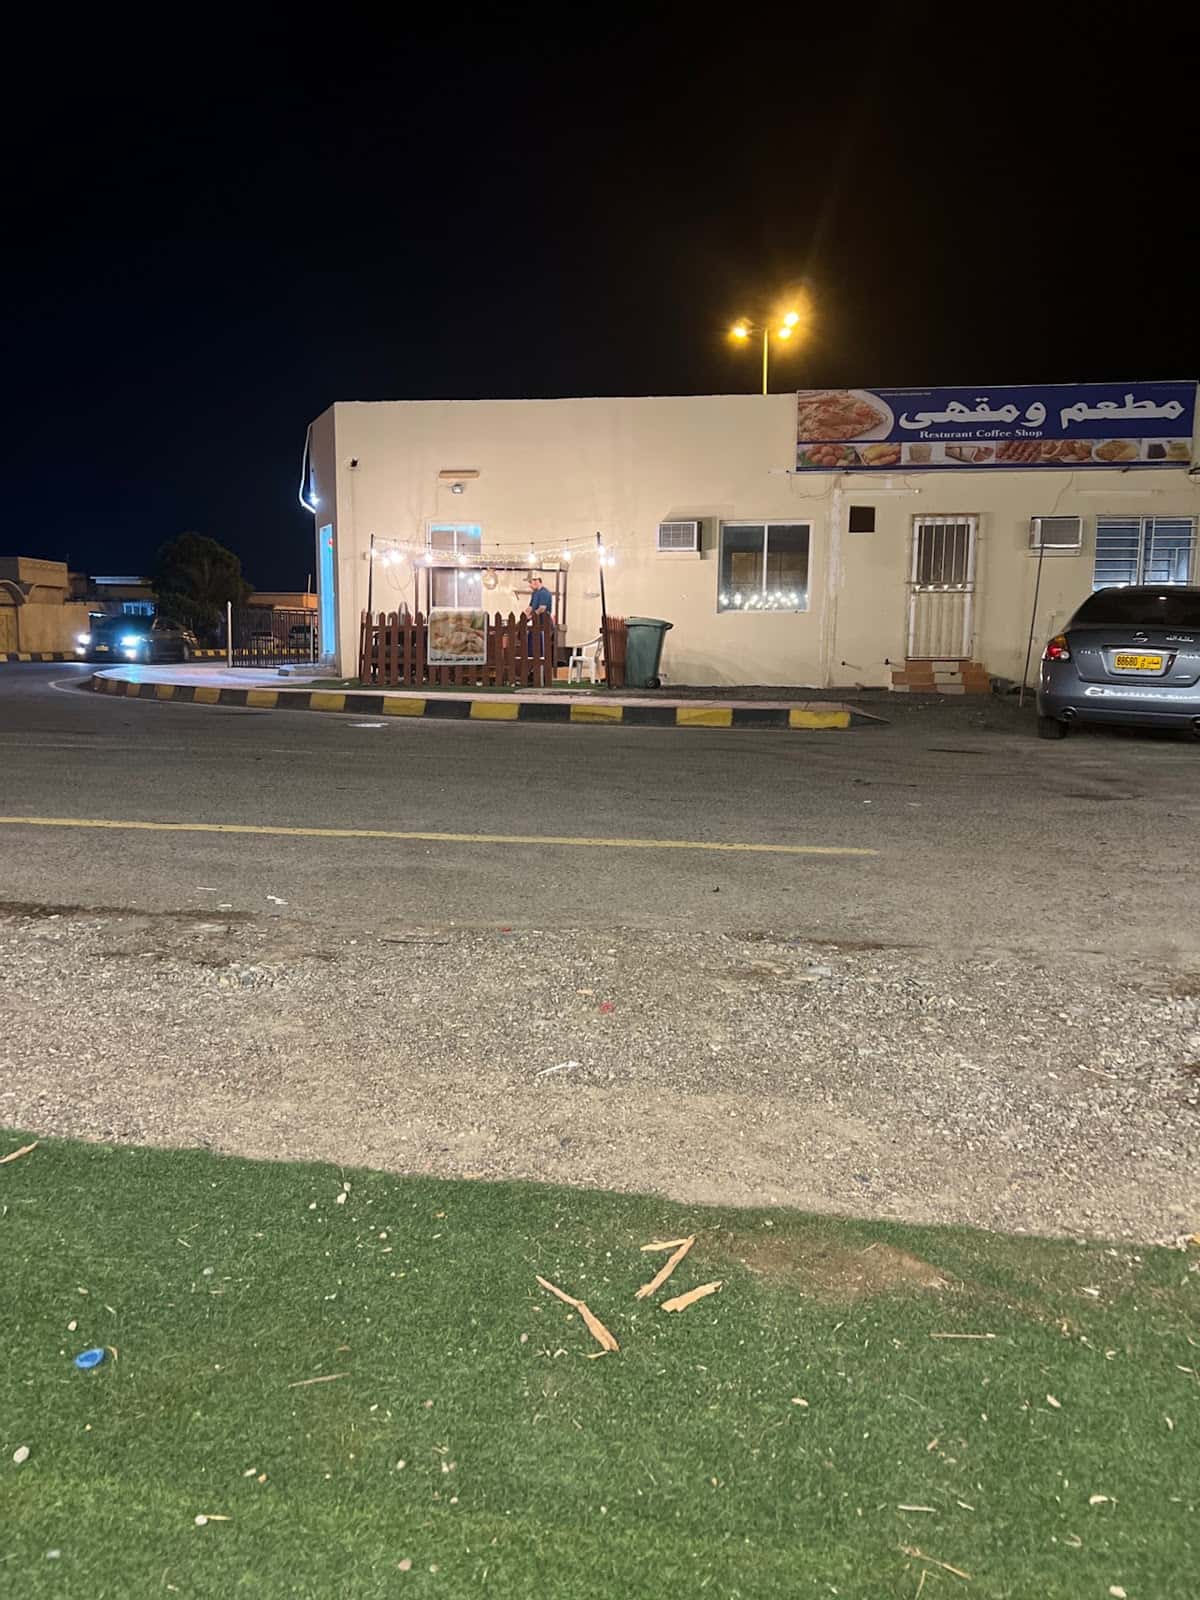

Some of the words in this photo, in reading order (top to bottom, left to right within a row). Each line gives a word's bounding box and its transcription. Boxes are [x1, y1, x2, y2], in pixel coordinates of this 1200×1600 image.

[1060, 393, 1185, 430] مطعم
[919, 430, 973, 439] Resturant
[976, 429, 1012, 438] Coffee
[1015, 428, 1043, 438] Shop
